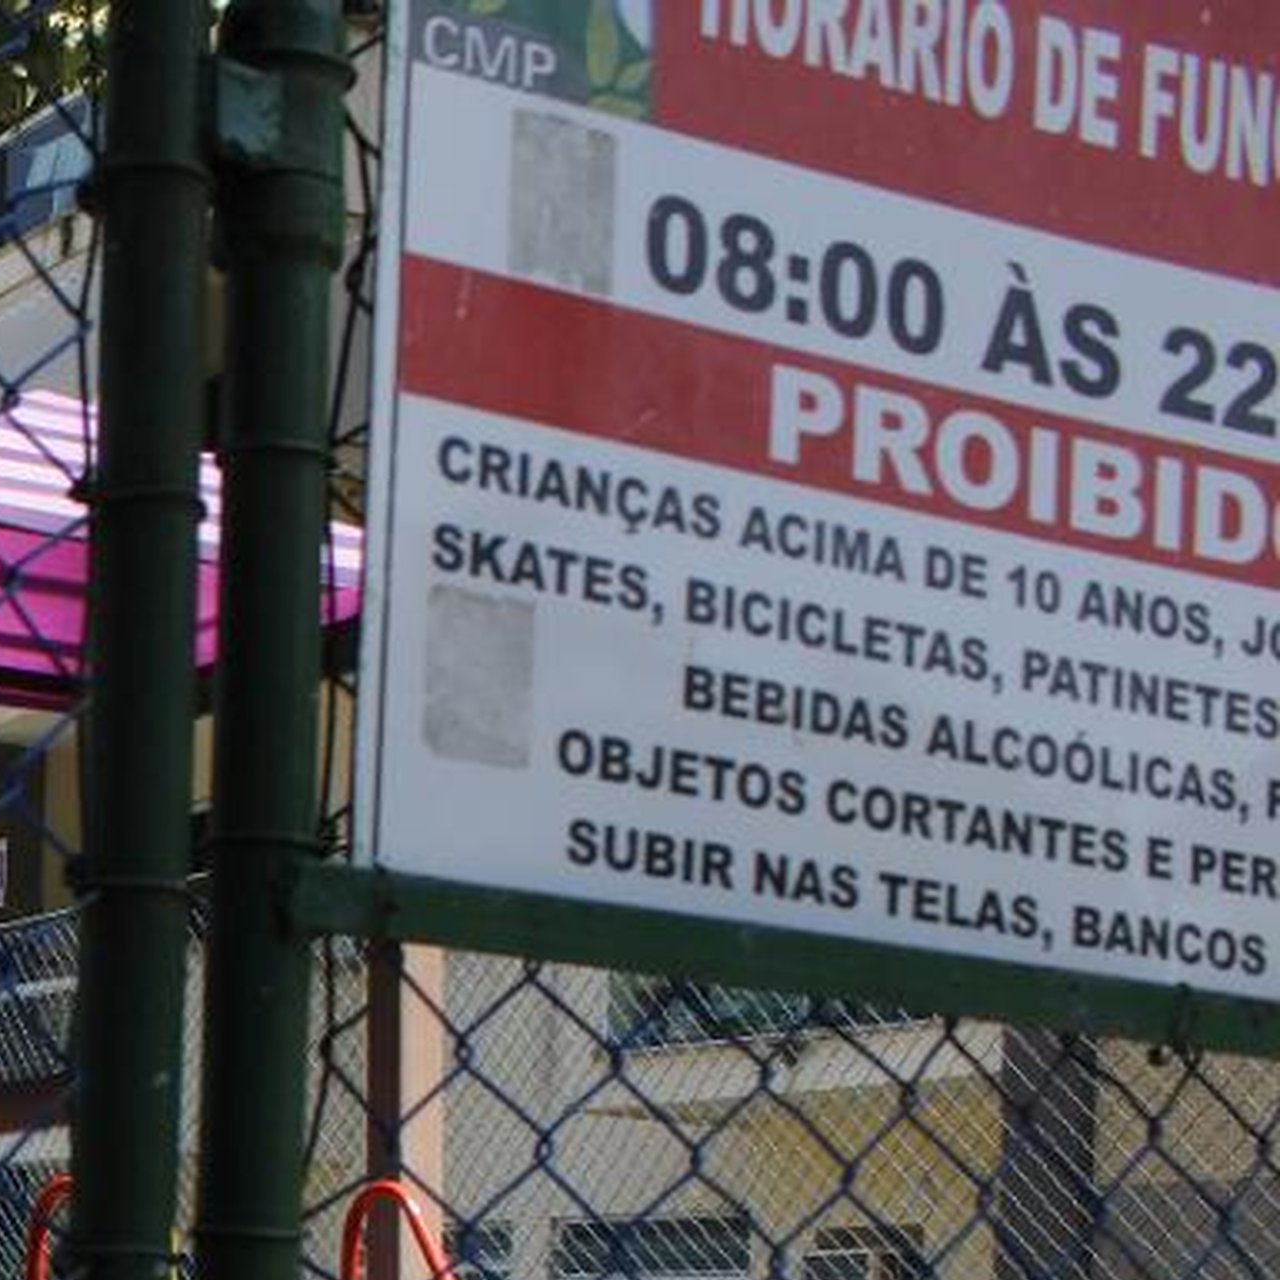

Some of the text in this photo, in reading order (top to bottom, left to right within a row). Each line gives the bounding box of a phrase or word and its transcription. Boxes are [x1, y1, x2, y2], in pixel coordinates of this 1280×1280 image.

[423, 15, 557, 88] CMP
[1035, 15, 1122, 149] DE
[1140, 44, 1280, 187] FUN
[646, 196, 1277, 438] 08:00 ÀS 22
[438, 436, 721, 537] CRIANÇAS
[741, 505, 907, 581] ACIMA
[925, 541, 988, 599] DE
[1007, 565, 1061, 614] 10
[1077, 580, 1224, 660] ANOS,
[769, 365, 1280, 565] PROIBID
[432, 523, 1278, 739] SKATES, BICICLETAS, PATINETES
[557, 729, 1278, 900] OBJETOS CORTANTES E PER
[683, 665, 908, 747] BEBIDAS
[926, 713, 1250, 826] ALCOÓLICAS,
[567, 819, 1268, 977] SUBIR NAS TELAS, BANCOS
